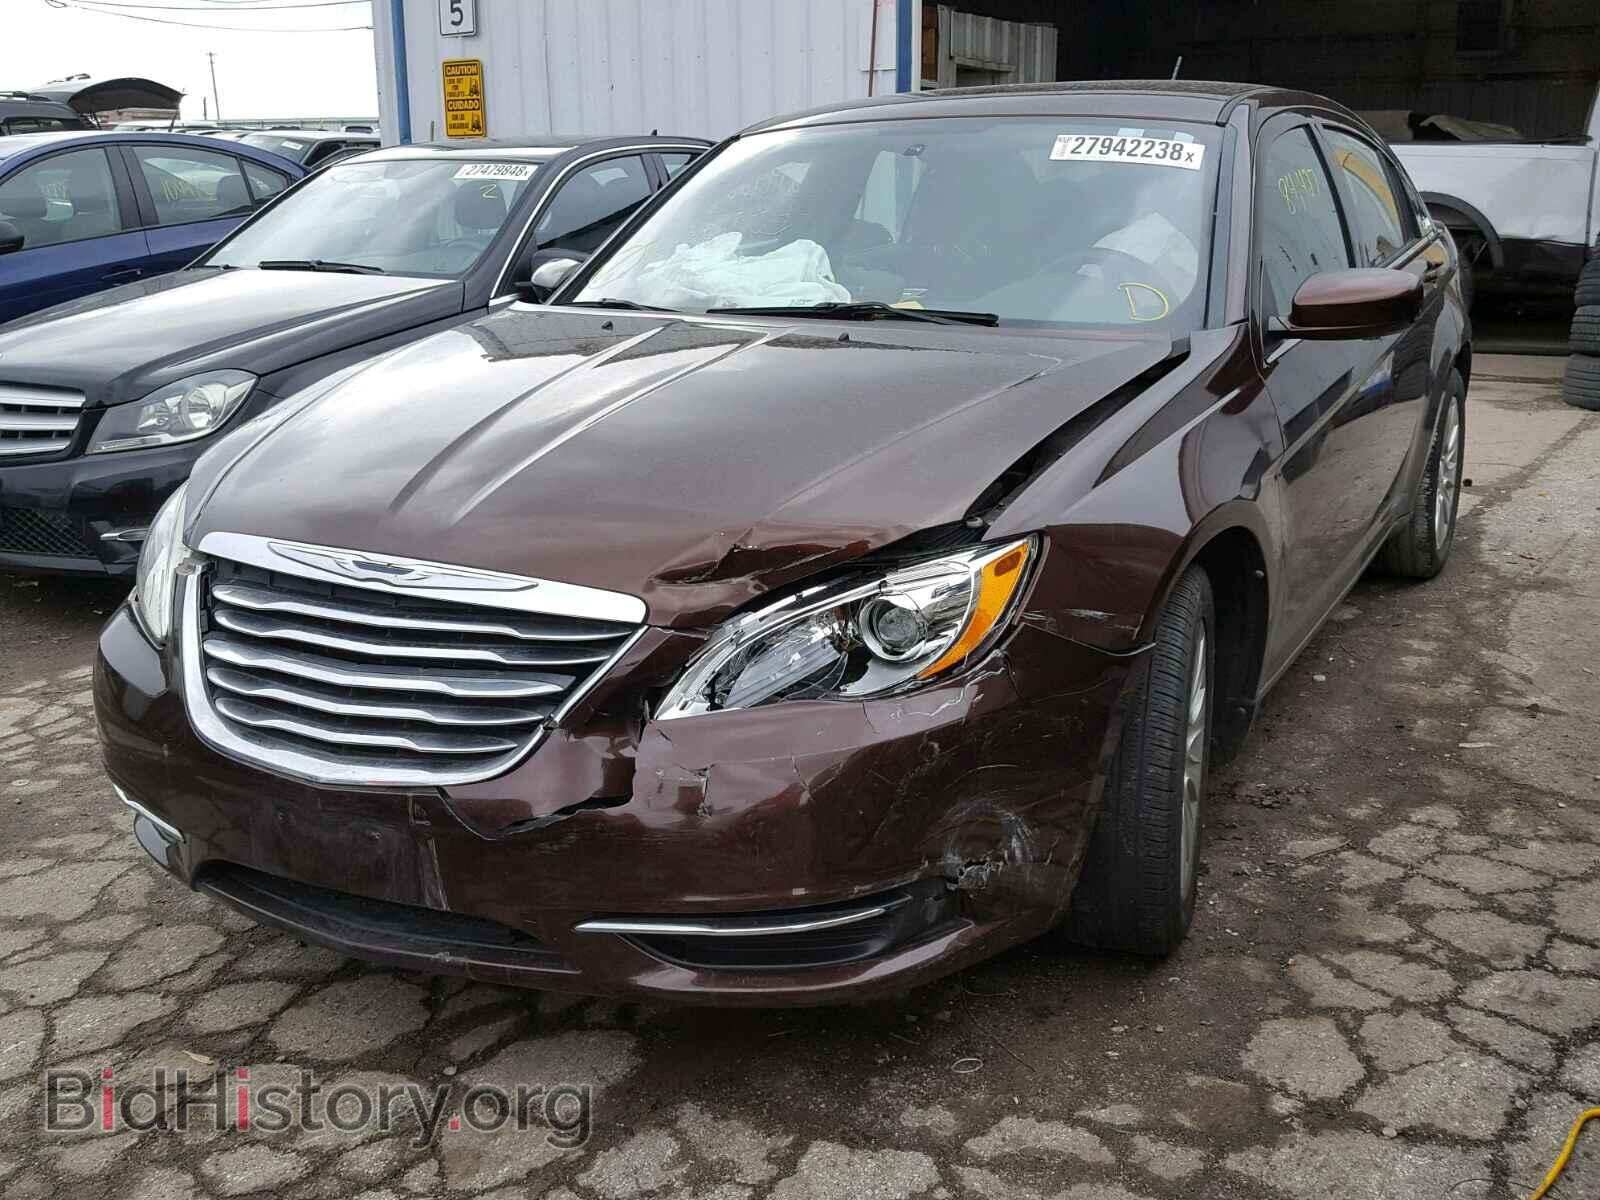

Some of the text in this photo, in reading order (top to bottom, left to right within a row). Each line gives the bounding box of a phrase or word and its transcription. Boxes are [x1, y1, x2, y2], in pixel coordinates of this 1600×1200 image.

[450, 0, 464, 27] 5
[446, 65, 480, 76] CAUTION
[448, 100, 480, 111] CUIDADO
[1117, 282, 1169, 321] D
